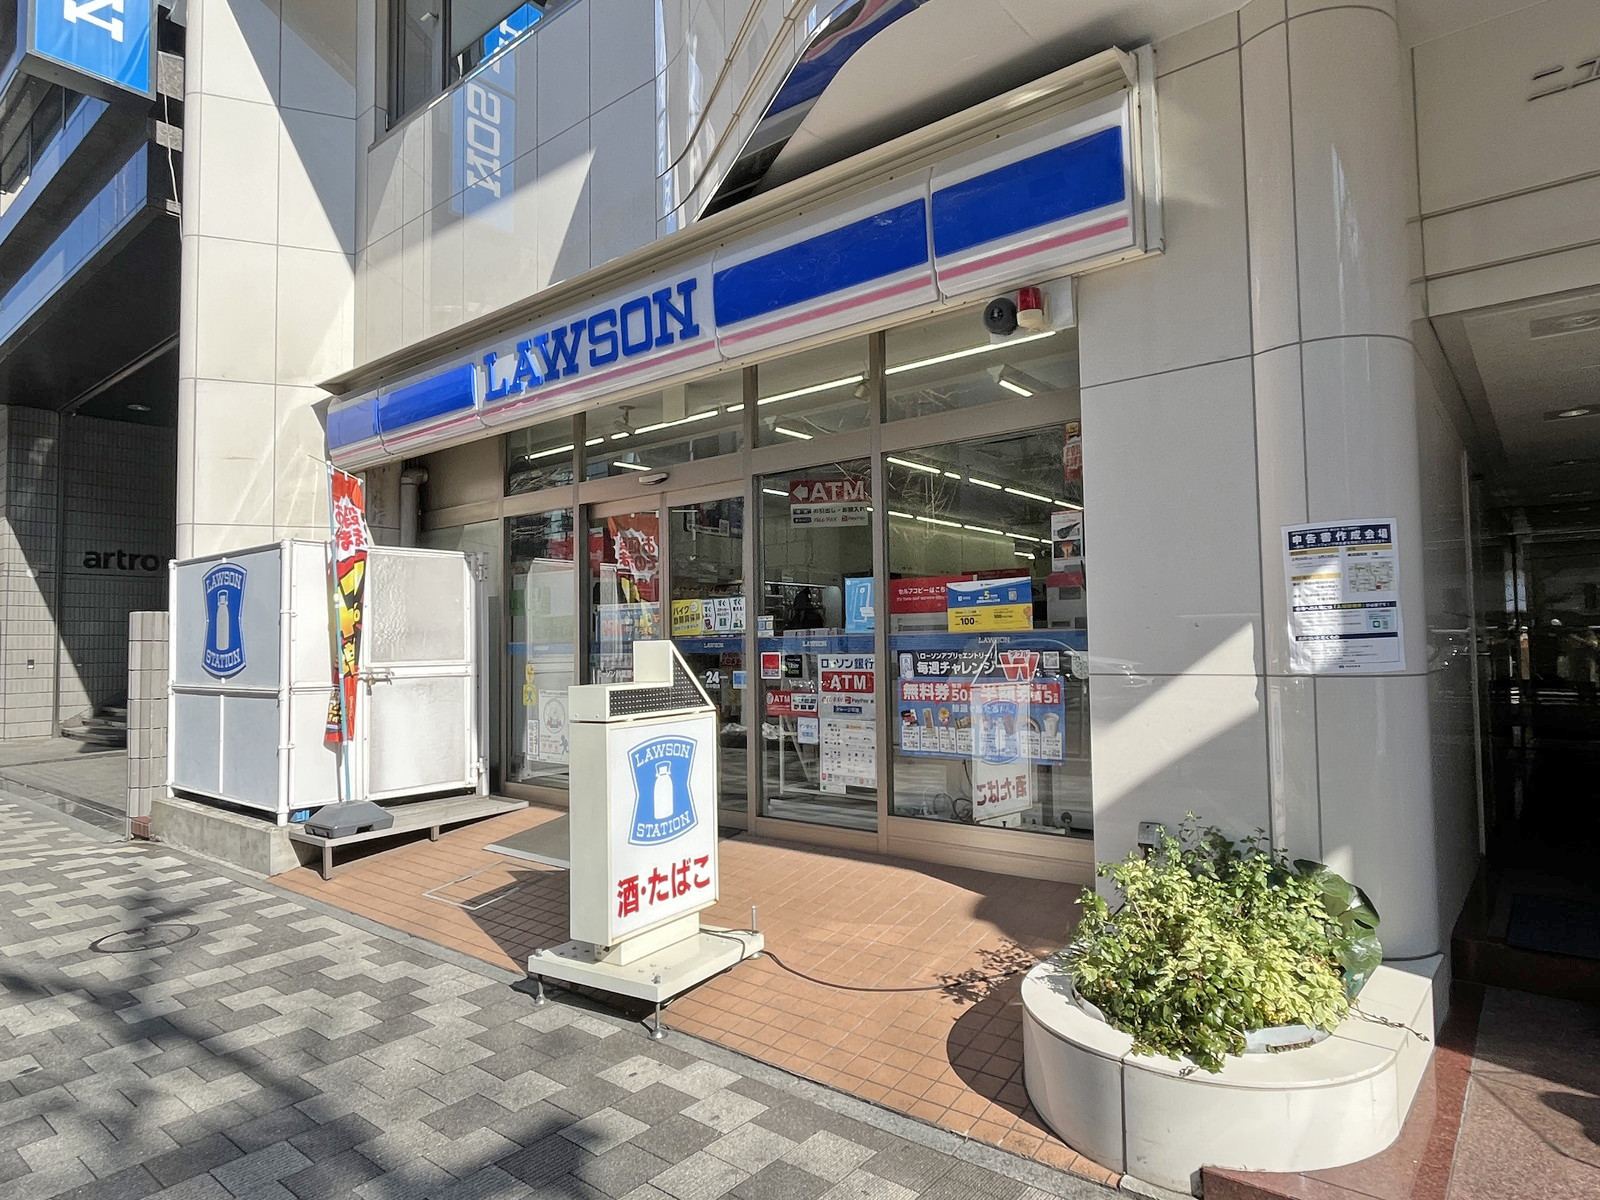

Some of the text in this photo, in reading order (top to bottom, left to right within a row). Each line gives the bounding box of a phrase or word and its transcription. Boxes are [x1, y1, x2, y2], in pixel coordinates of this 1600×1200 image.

[482, 277, 700, 402] LAWSON
[809, 480, 865, 502] ATM
[206, 571, 242, 593] LAWSON
[960, 617, 975, 625] 100
[205, 648, 240, 668] STATION
[917, 661, 995, 675] 毎週チャレンジ
[706, 671, 719, 683] 24
[829, 675, 867, 690] ATM
[902, 683, 949, 701] 無料券
[635, 743, 691, 768] LAWSON
[636, 811, 691, 839] STATION
[617, 855, 710, 918] 酒・たばこ
